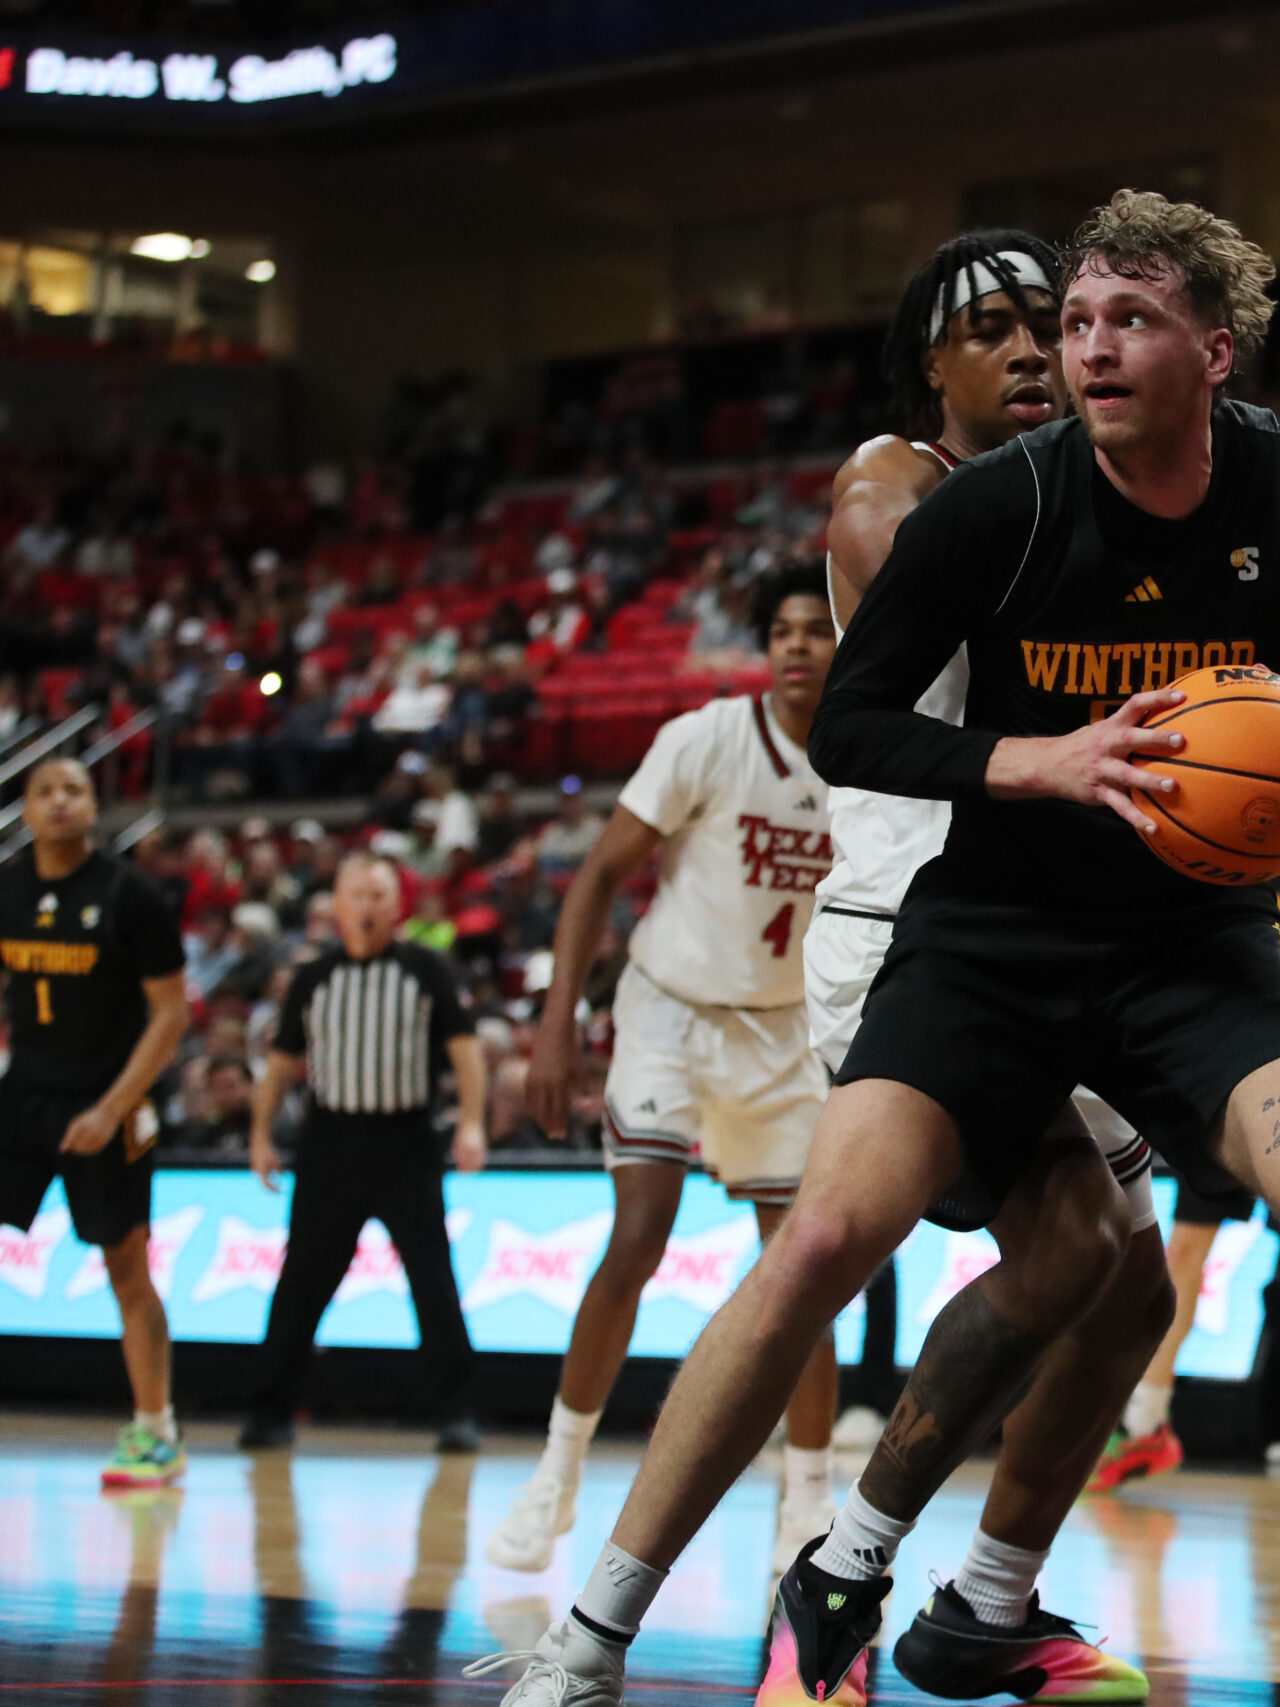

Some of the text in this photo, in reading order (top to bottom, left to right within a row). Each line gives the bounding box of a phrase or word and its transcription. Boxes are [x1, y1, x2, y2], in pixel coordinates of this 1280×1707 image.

[25, 46, 159, 99] Davis
[737, 814, 835, 864] TEXA
[761, 902, 795, 958] 4
[36, 979, 54, 1025] 1
